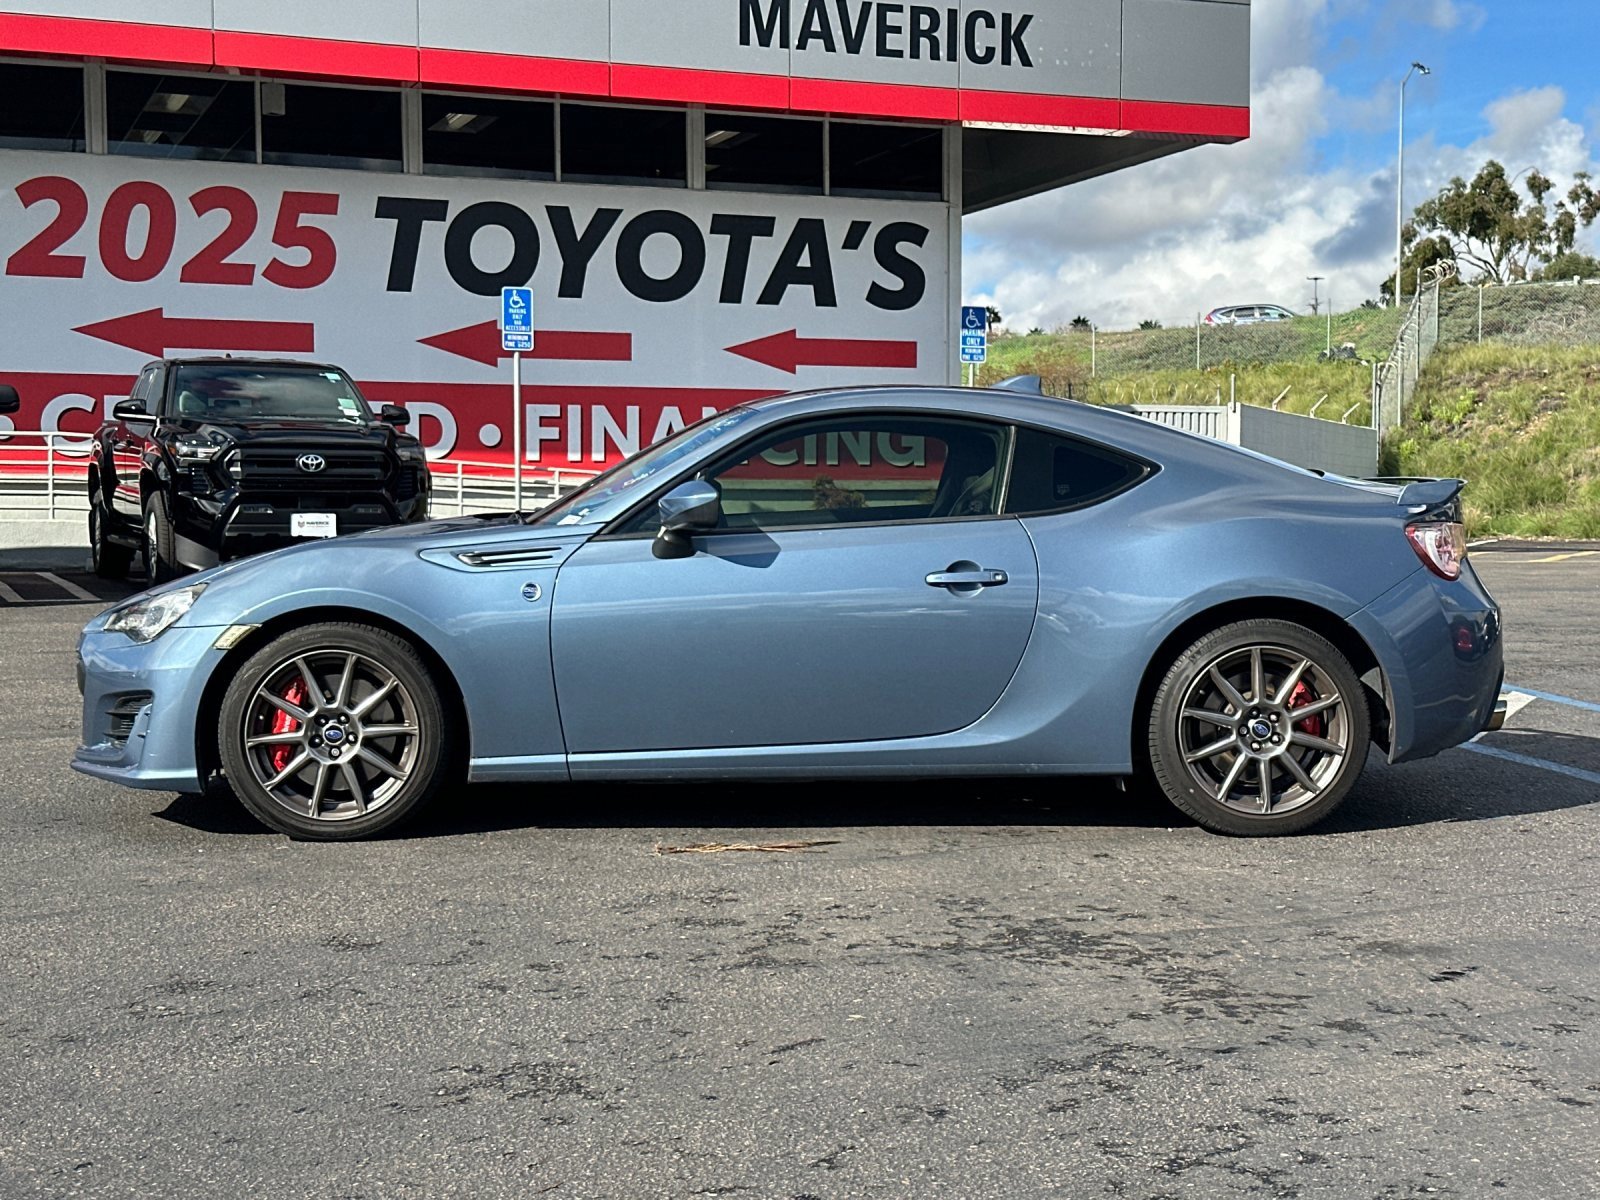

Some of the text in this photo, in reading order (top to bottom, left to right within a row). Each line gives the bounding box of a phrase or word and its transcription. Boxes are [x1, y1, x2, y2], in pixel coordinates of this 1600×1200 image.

[739, 0, 1034, 68] MAVERICK
[6, 176, 930, 310] 2025 TOYOTA'S
[962, 329, 985, 337] PARKING
[966, 337, 981, 346] ONLY
